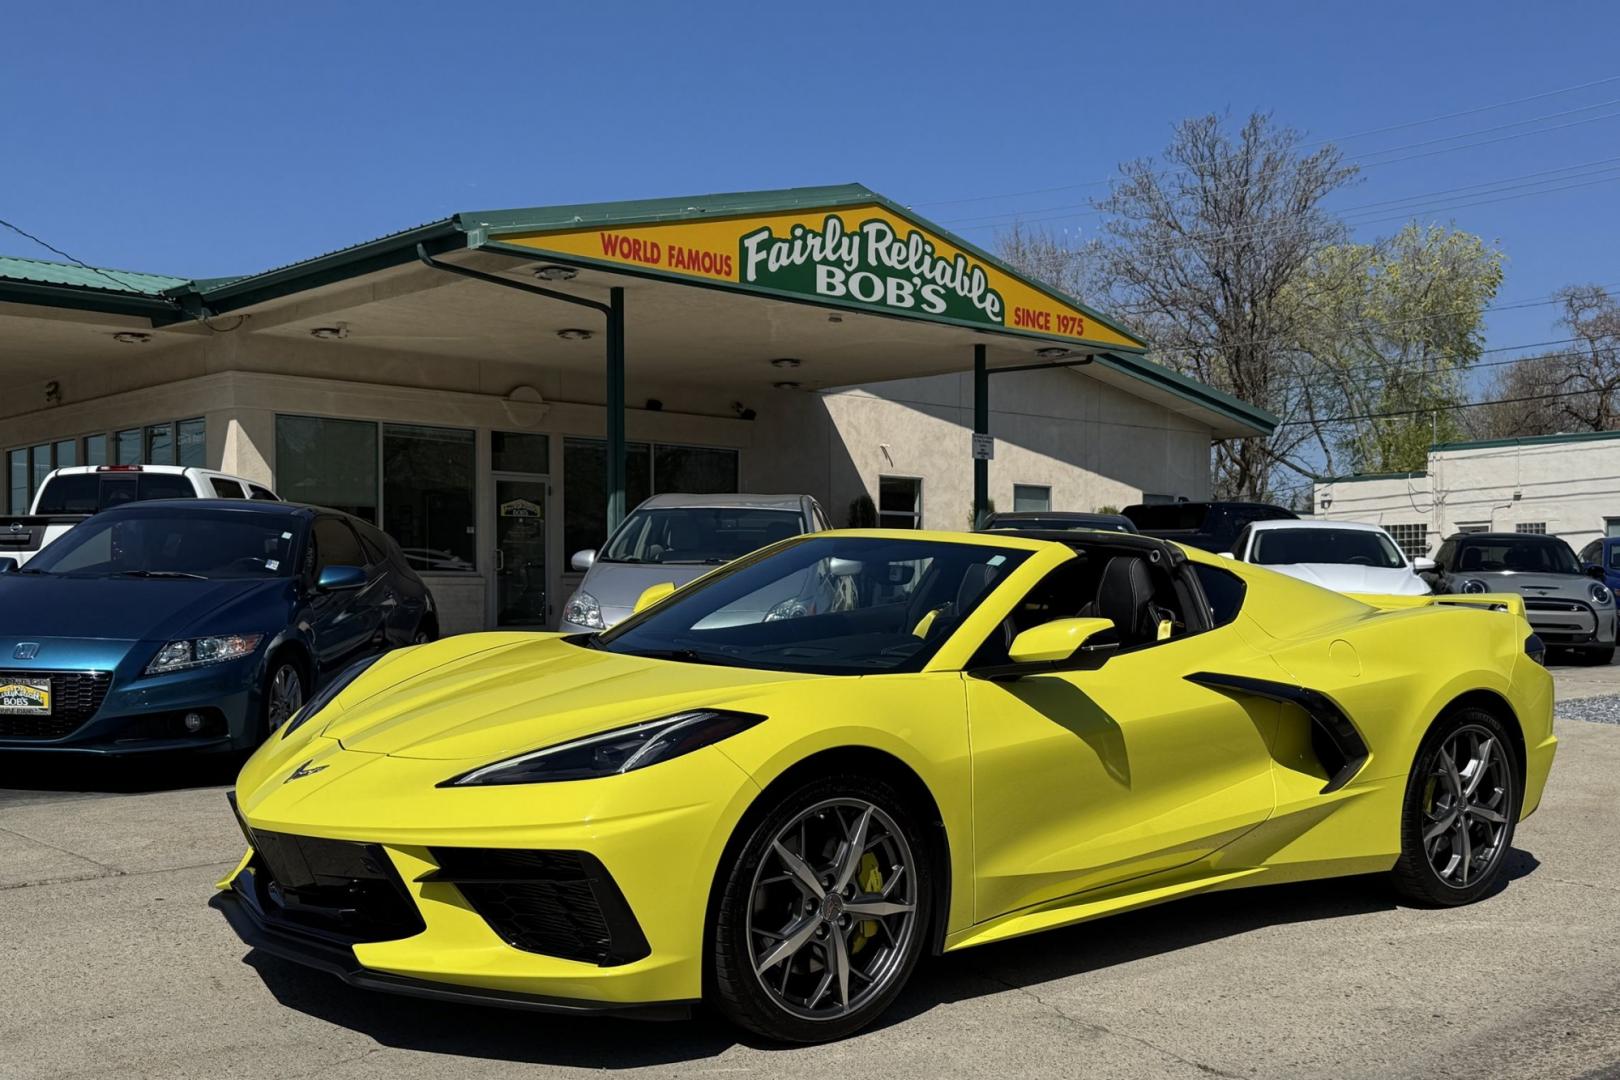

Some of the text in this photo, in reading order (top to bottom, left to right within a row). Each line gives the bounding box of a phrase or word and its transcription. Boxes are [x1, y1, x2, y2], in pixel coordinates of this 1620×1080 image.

[601, 233, 732, 276] WORLD FAMOUS
[744, 218, 1002, 321] Fairly Reliable
[816, 264, 947, 313] BOB'S
[1014, 307, 1084, 336] SINCE 1975
